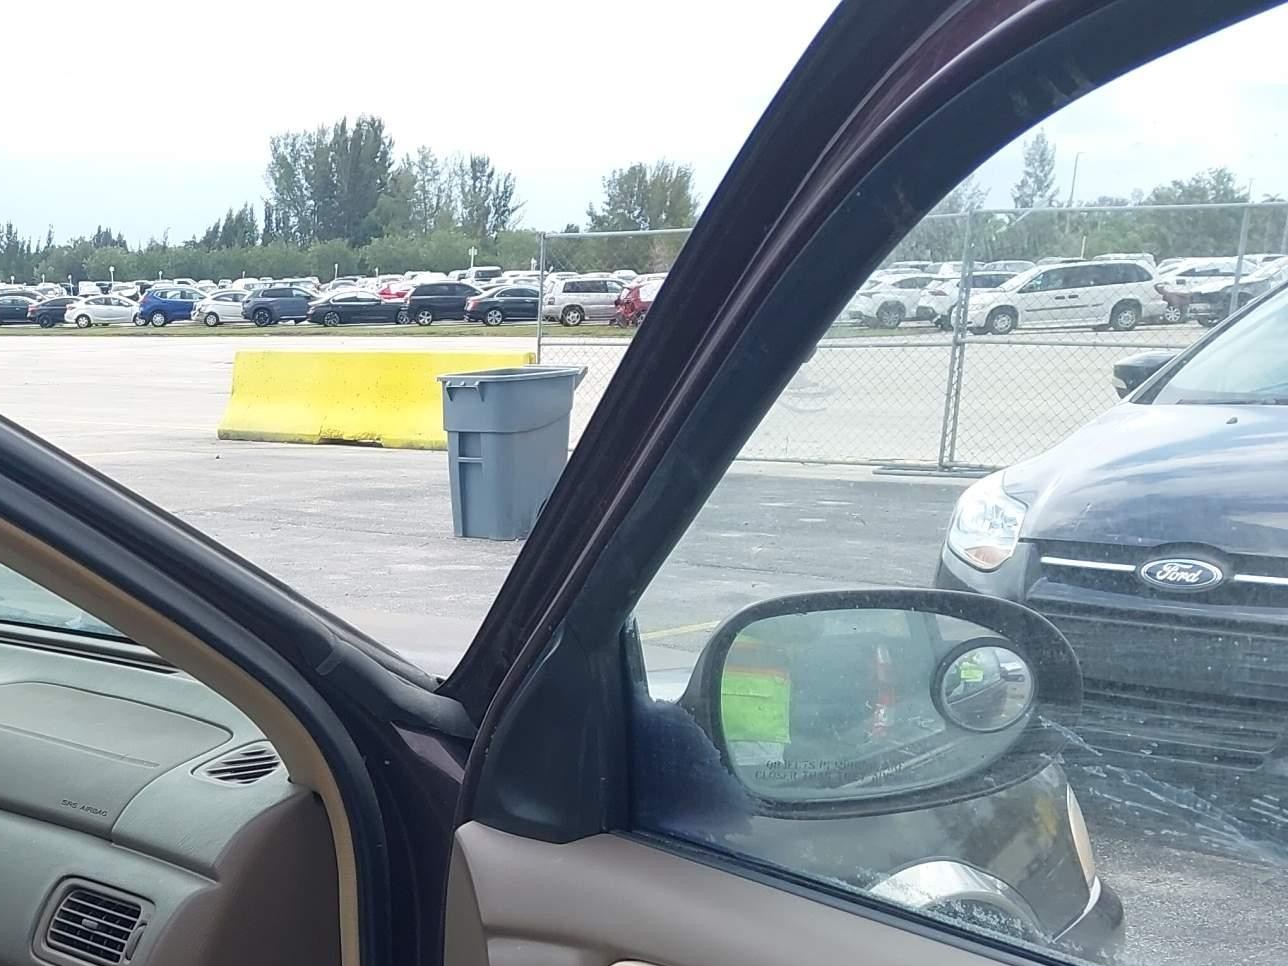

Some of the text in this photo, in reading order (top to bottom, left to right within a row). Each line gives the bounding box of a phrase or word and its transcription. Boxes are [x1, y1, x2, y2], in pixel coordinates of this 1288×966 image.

[1157, 563, 1201, 583] Ford
[62, 799, 108, 817] SRS AIRBAG
